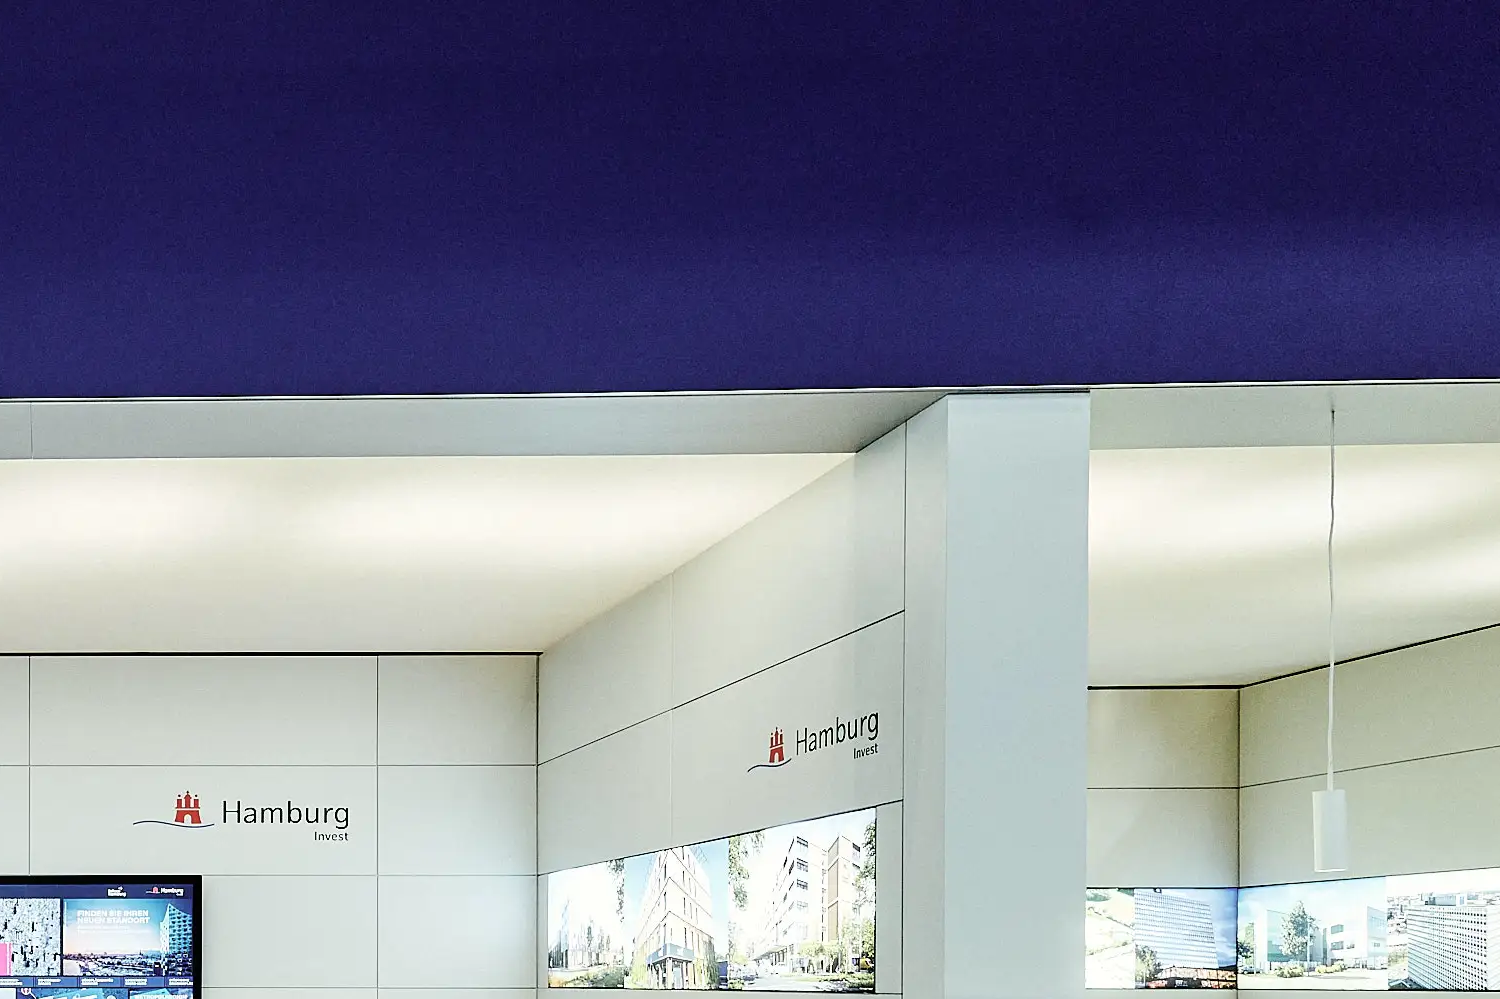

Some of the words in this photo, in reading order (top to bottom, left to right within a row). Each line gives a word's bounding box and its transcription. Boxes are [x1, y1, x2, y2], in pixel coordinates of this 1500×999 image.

[796, 711, 879, 756] Hamburg
[853, 743, 879, 760] Invest
[222, 800, 349, 829] Hamburg
[314, 831, 349, 842] Invest
